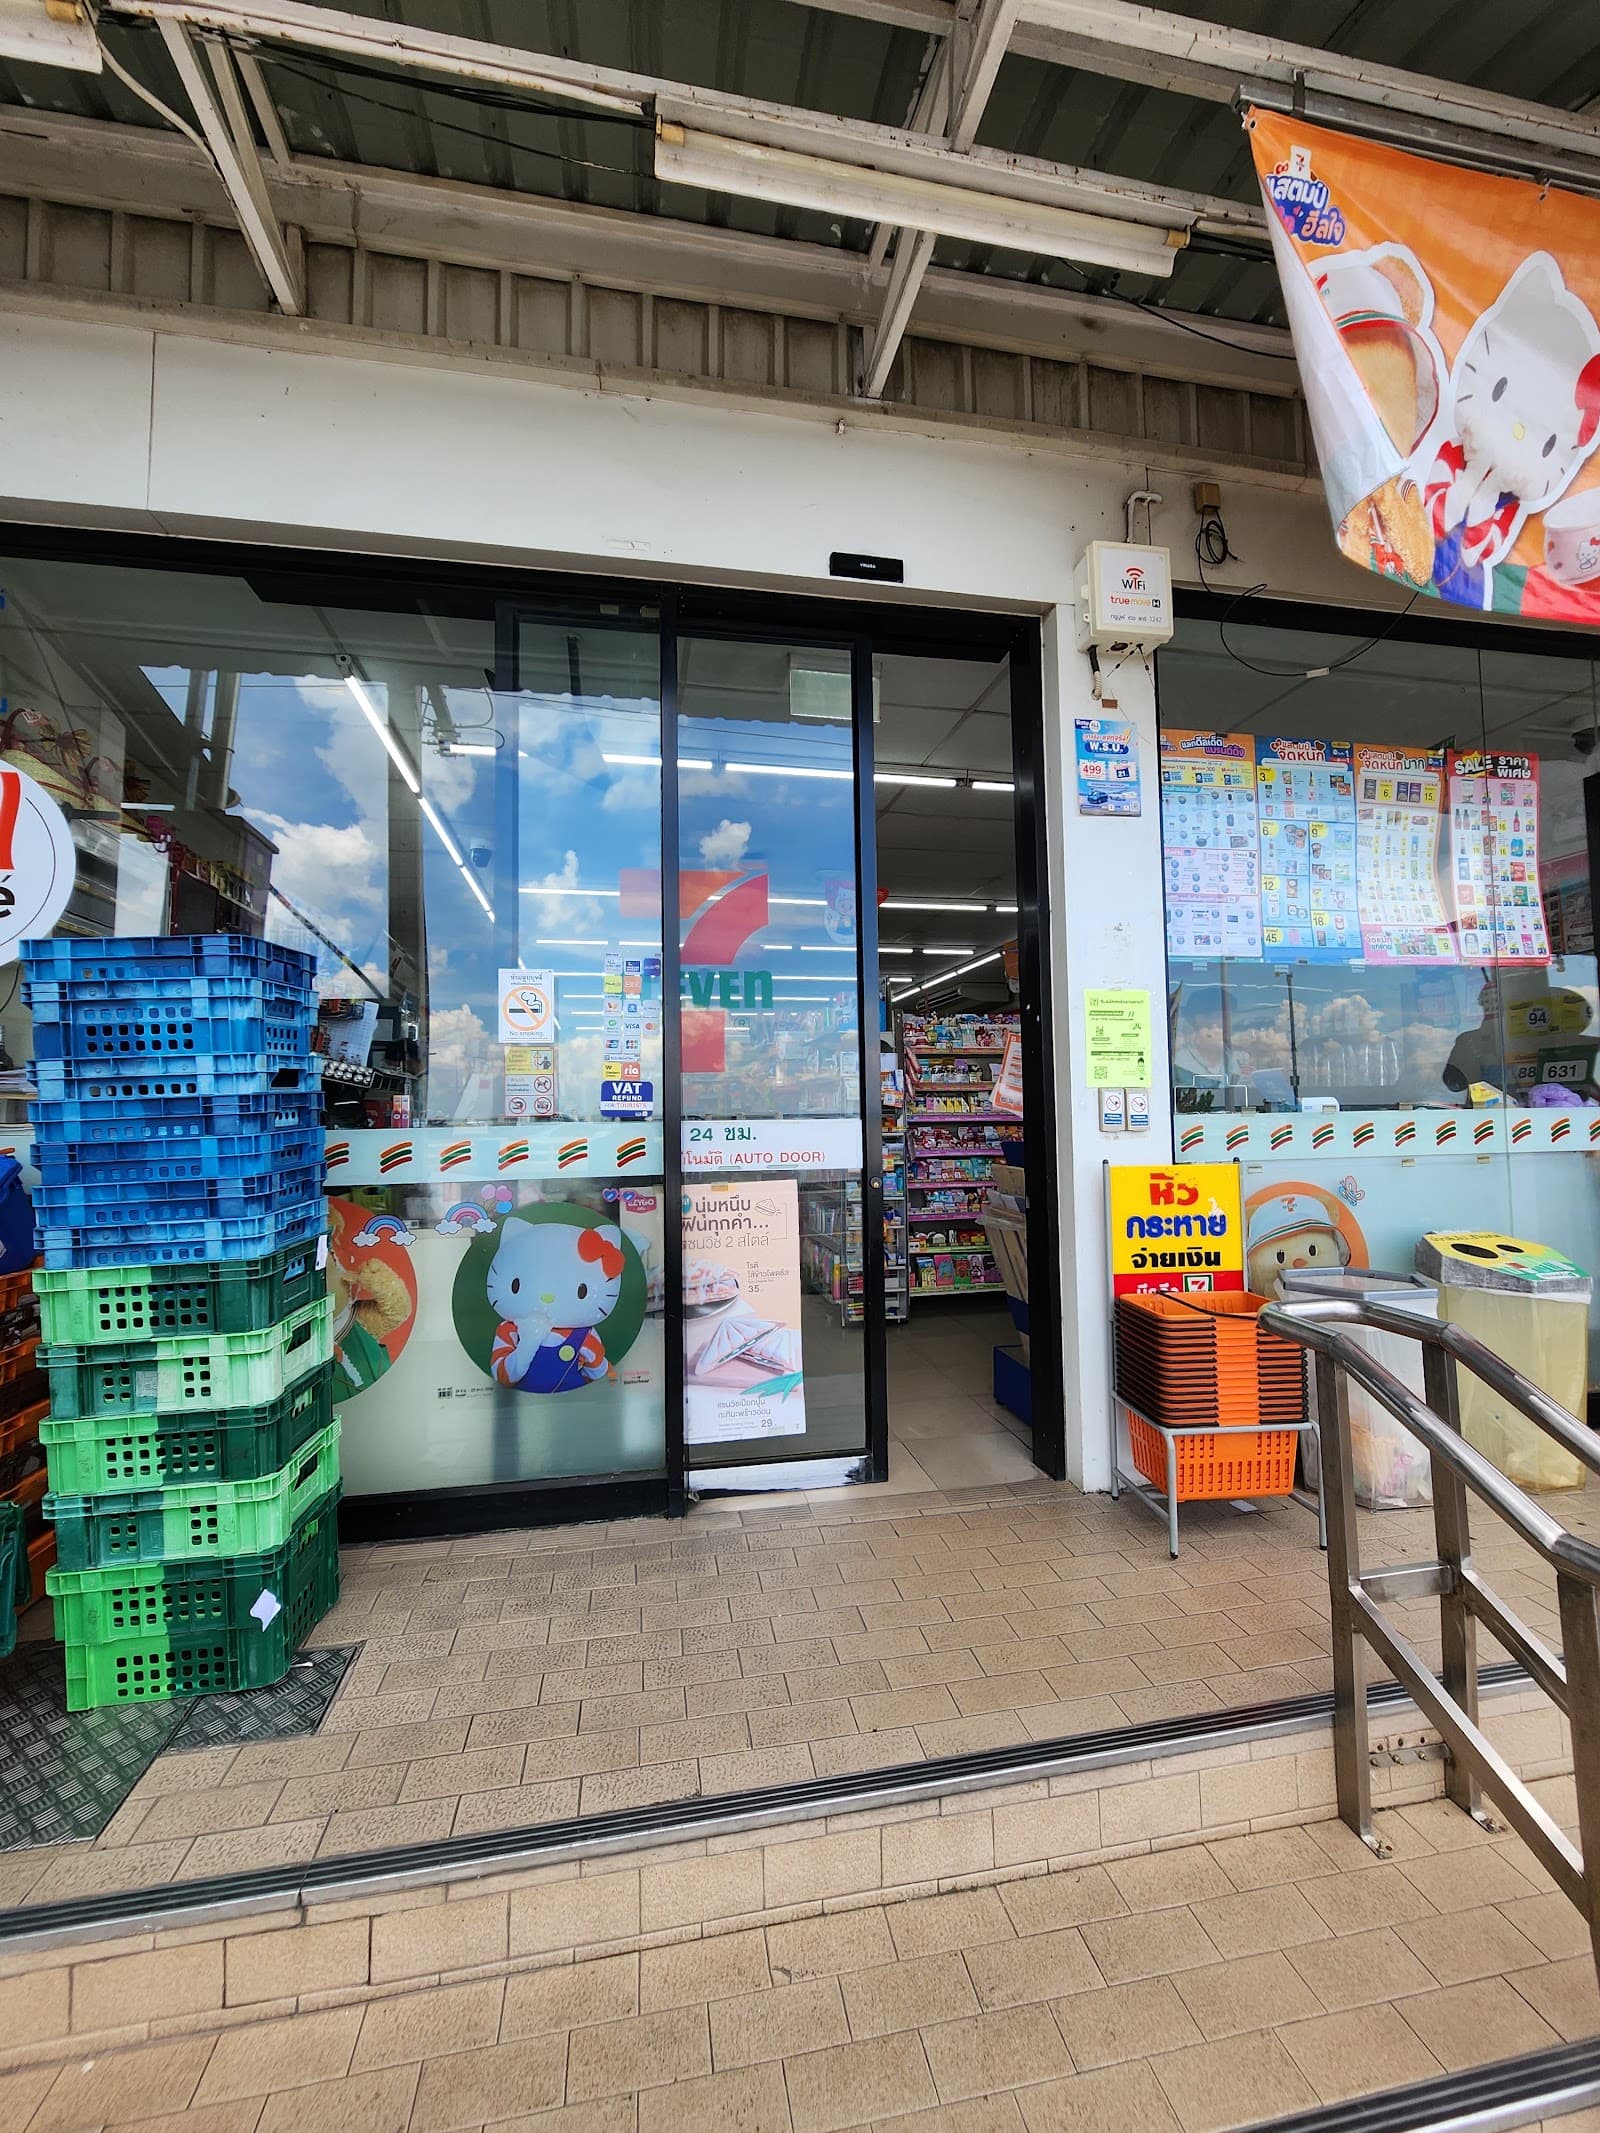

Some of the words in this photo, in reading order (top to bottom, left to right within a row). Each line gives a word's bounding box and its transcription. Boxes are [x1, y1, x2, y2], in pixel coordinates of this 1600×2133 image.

[1278, 747, 1324, 761] จัดหนัก
[1454, 754, 1494, 775] SALE
[1498, 755, 1529, 768] ราคา
[1082, 765, 1102, 775] 499
[1497, 765, 1532, 778] พิเศษ
[1259, 772, 1266, 782] 3
[1262, 827, 1269, 835] 6
[1312, 828, 1318, 838] 9
[1264, 881, 1274, 890] 12
[1313, 916, 1324, 926] 18
[1266, 934, 1277, 943] 45
[1529, 1012, 1547, 1025] 94
[624, 1064, 639, 1075] ria
[1548, 1064, 1577, 1078] 631
[612, 1083, 642, 1094] VAT
[689, 1127, 713, 1141] 24
[730, 1151, 773, 1165] (AUTO
[780, 1151, 825, 1164] DOOR)
[695, 1194, 751, 1218] นุ่มหนึบ
[1126, 1213, 1227, 1239] กระหาย
[725, 1236, 734, 1248] 2
[737, 1232, 769, 1247] สไตล์
[1130, 1246, 1221, 1270] จ่ายเงิน
[748, 1285, 760, 1293] 35
[761, 1419, 773, 1428] 29
